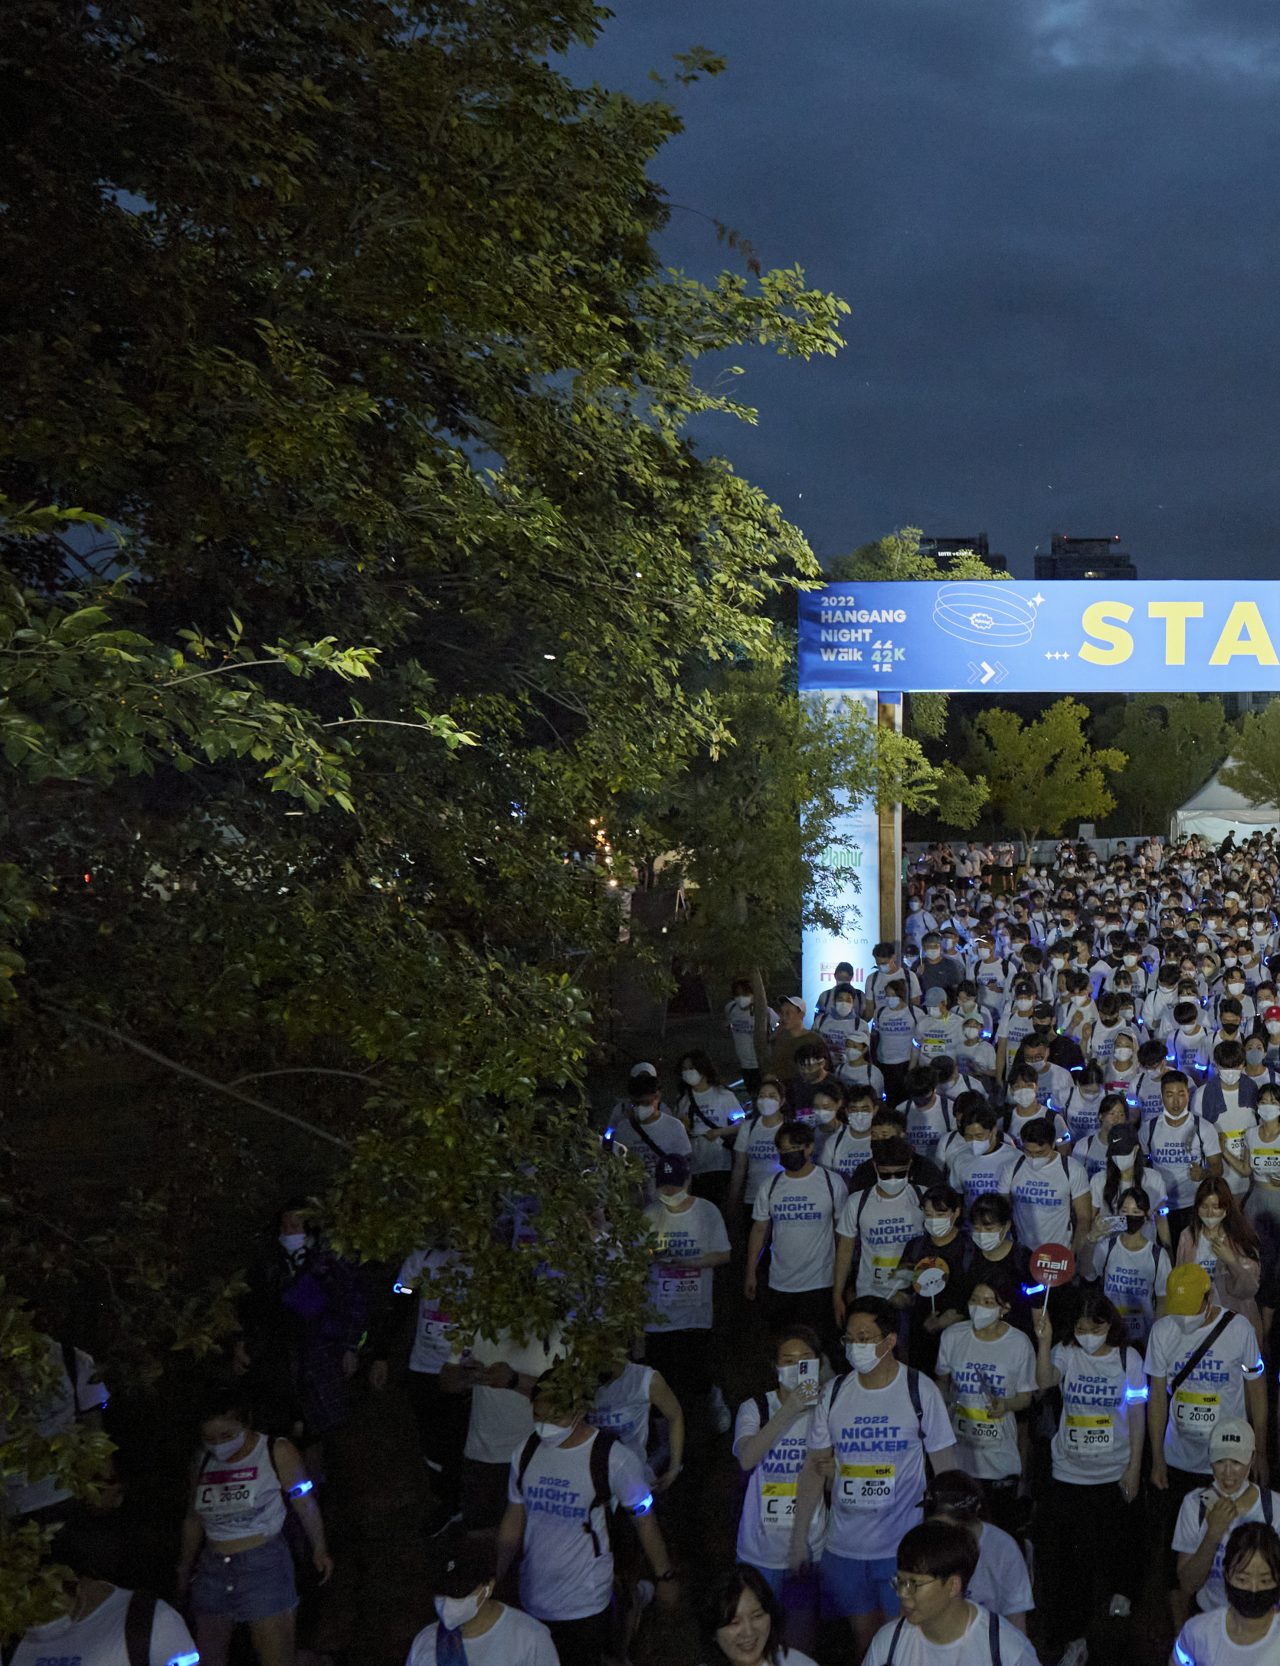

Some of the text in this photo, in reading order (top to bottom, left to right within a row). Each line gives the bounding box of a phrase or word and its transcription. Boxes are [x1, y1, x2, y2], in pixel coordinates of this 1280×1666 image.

[821, 596, 855, 607] 2022
[821, 609, 907, 624] HANGANG
[821, 629, 873, 643] NIGHT
[821, 967, 864, 981] mll
[1017, 1186, 1057, 1198] NIGHT
[774, 1203, 816, 1212] NIGHT
[870, 1225, 914, 1236] NIGHT
[1036, 1260, 1068, 1271] mall
[1108, 1274, 1147, 1285] NIGHT
[1068, 1382, 1117, 1396] NIGHT
[1177, 1404, 1185, 1419] C
[1189, 1411, 1216, 1423] 20:00
[854, 1416, 888, 1425] 2022
[841, 1427, 901, 1439] NIGHT
[973, 1427, 998, 1438] 20:00
[1070, 1430, 1078, 1443] C
[1083, 1434, 1110, 1444] 20:00
[843, 1480, 854, 1495] C
[861, 1486, 891, 1498] 20:00
[219, 1489, 250, 1503] 20:00
[527, 1486, 581, 1502] NIGHT
[767, 1500, 778, 1514] C
